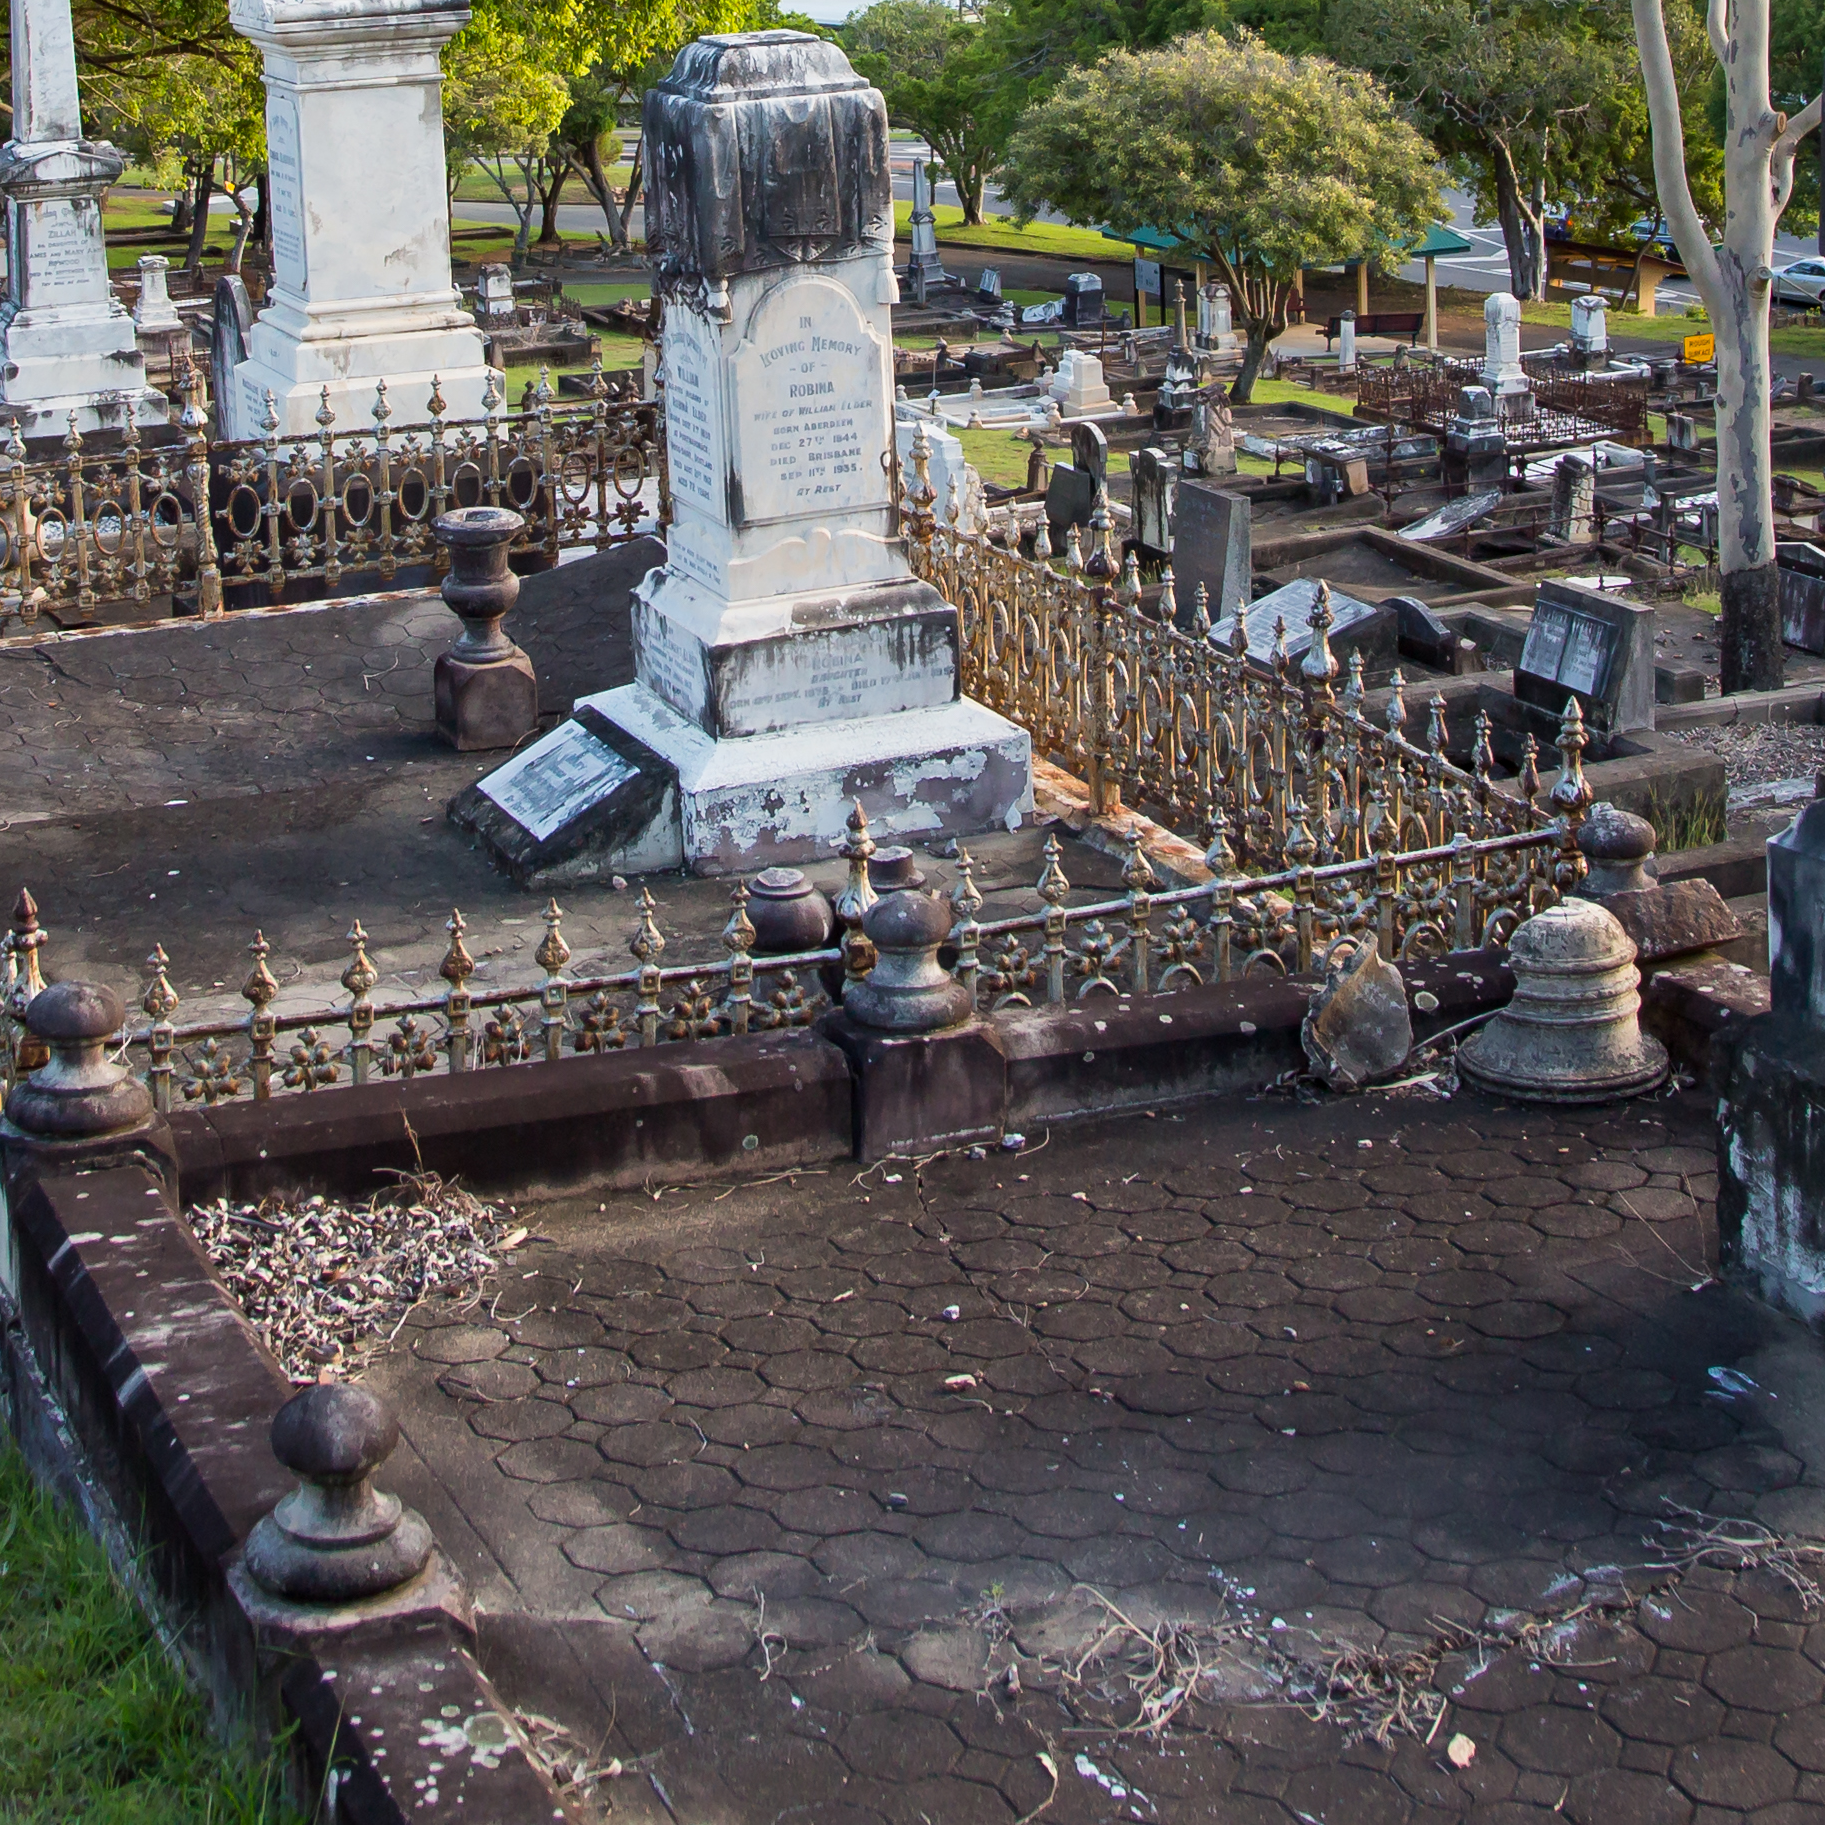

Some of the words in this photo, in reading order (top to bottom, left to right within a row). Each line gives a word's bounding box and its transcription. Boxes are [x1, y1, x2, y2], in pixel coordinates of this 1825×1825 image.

[48, 230, 77, 238] ZILLAH
[799, 316, 813, 329] IN
[759, 339, 806, 369] LOVING
[811, 335, 862, 357] MEMORY
[789, 381, 835, 399] ROBINA
[781, 407, 795, 419] OF
[798, 403, 837, 417] WILLIAM
[840, 398, 873, 412] ELDER
[773, 423, 799, 435] BORN
[803, 417, 854, 432] ABERDEEN
[770, 440, 791, 452] DEC
[769, 455, 797, 467] DIED
[807, 446, 862, 462] BRISBANE
[780, 471, 802, 481] SEP
[796, 487, 810, 496] AT
[814, 484, 842, 495] REST
[812, 652, 863, 670] ROBINA
[729, 698, 751, 710] ORN
